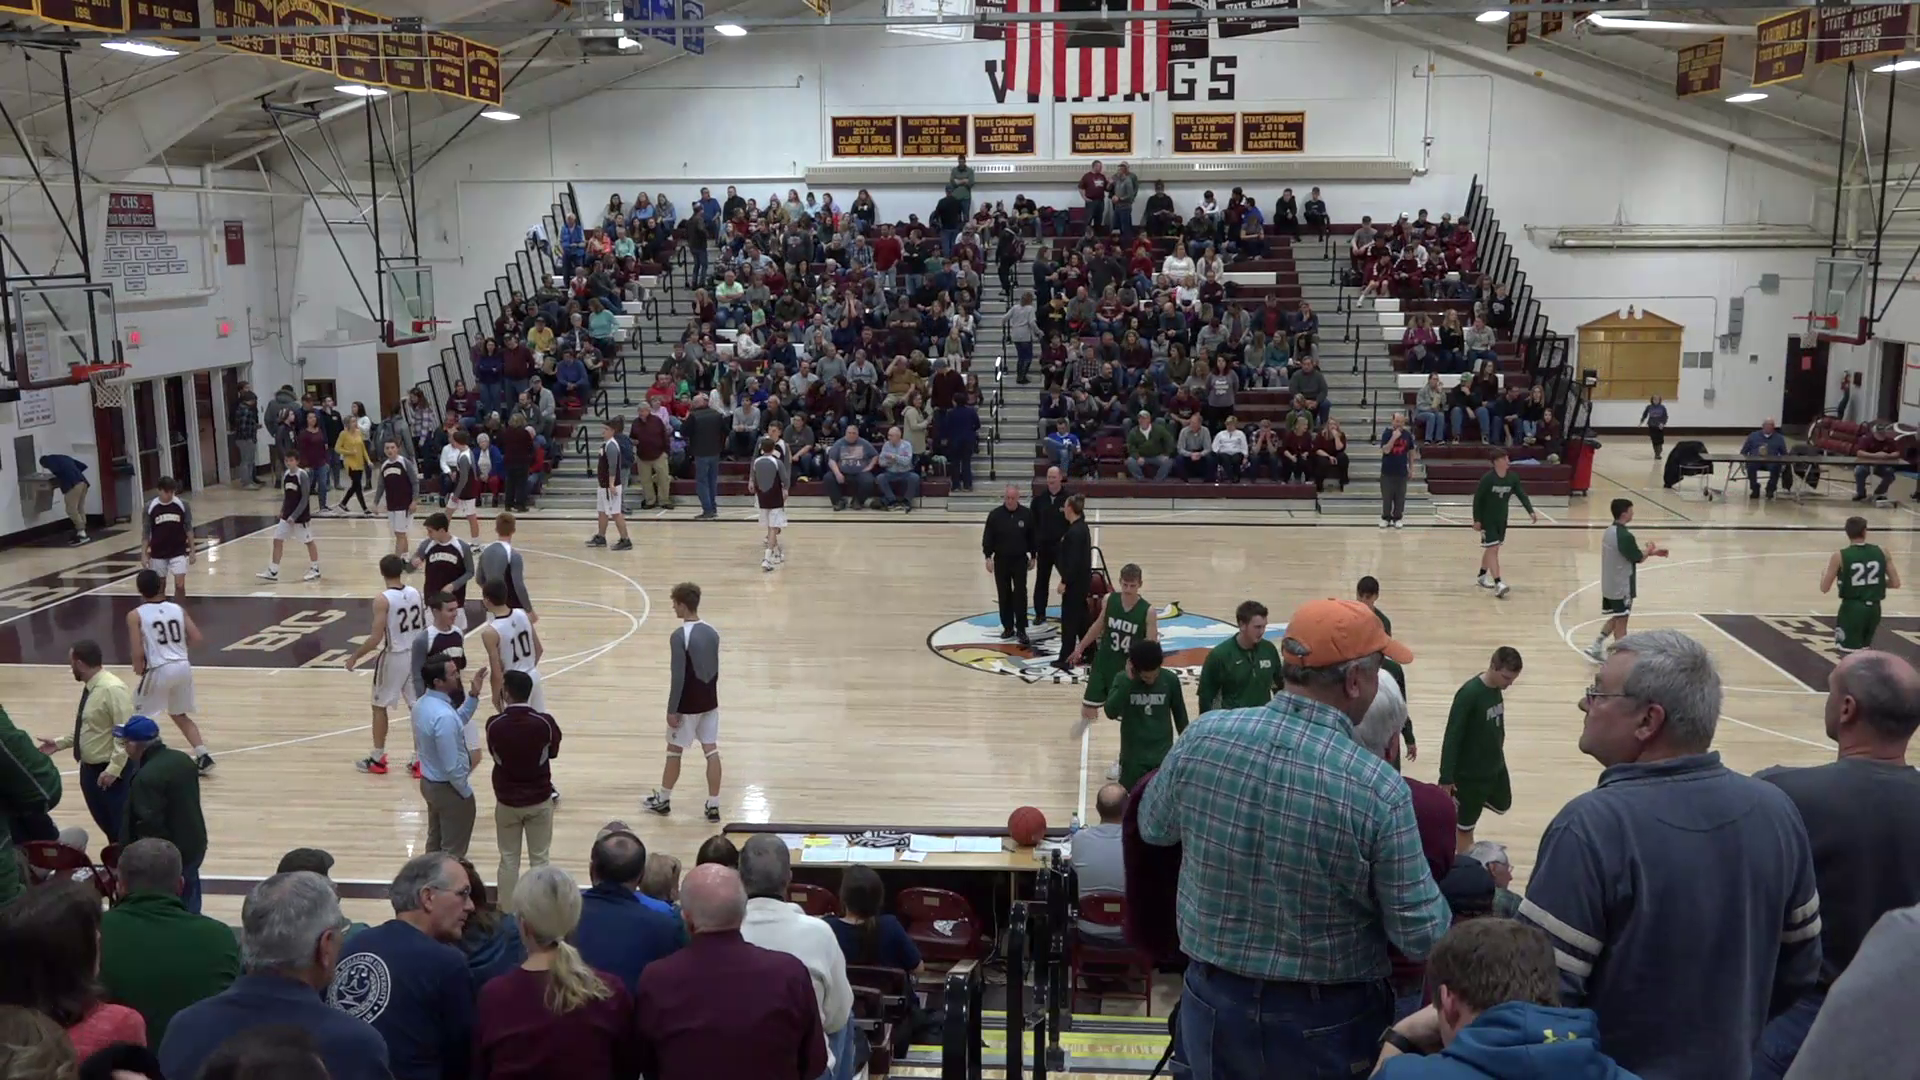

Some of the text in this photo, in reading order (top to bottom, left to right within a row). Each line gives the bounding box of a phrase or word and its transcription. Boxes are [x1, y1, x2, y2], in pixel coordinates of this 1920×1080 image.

[153, 5, 170, 19] EAST
[1824, 4, 1903, 31] STATE BASKETBALL
[1840, 23, 1883, 43] CHAMPIONS
[443, 38, 459, 52] EAST
[836, 118, 893, 127] NORTHERN MAINE
[908, 117, 961, 126] NORTHERN MAINE
[975, 117, 1033, 127] STATE CHAMPIONS
[1074, 116, 1130, 125] NORTHERN MAINE
[1175, 115, 1234, 125] STATE CHAMPIONS
[1244, 114, 1303, 124] STATE CHAMPIONS
[853, 127, 876, 135] 2017
[922, 127, 946, 135] 2017
[1078, 132, 1100, 140] CLASS
[1181, 132, 1203, 140] CLASS
[1210, 132, 1228, 140] BOYS
[1249, 131, 1272, 140] CLASS
[1278, 131, 1297, 139] BOYS
[839, 135, 862, 144] CLASS
[871, 135, 891, 144] GIRLS
[908, 135, 932, 144] CLASS
[941, 135, 961, 144] GIRLS
[981, 135, 1003, 143] CLASS
[990, 143, 1019, 151] TENNIS
[1191, 141, 1218, 150] TRACK
[1247, 140, 1297, 149] BASKETBALL
[120, 195, 139, 209] CHS
[1850, 560, 1880, 587] 22
[396, 604, 422, 634] 22
[1108, 616, 1139, 634] MDI
[152, 619, 182, 646] 30
[220, 609, 347, 652] BIG
[509, 629, 533, 664] 10
[1110, 631, 1132, 654] 34
[1129, 693, 1167, 706] FAMILY
